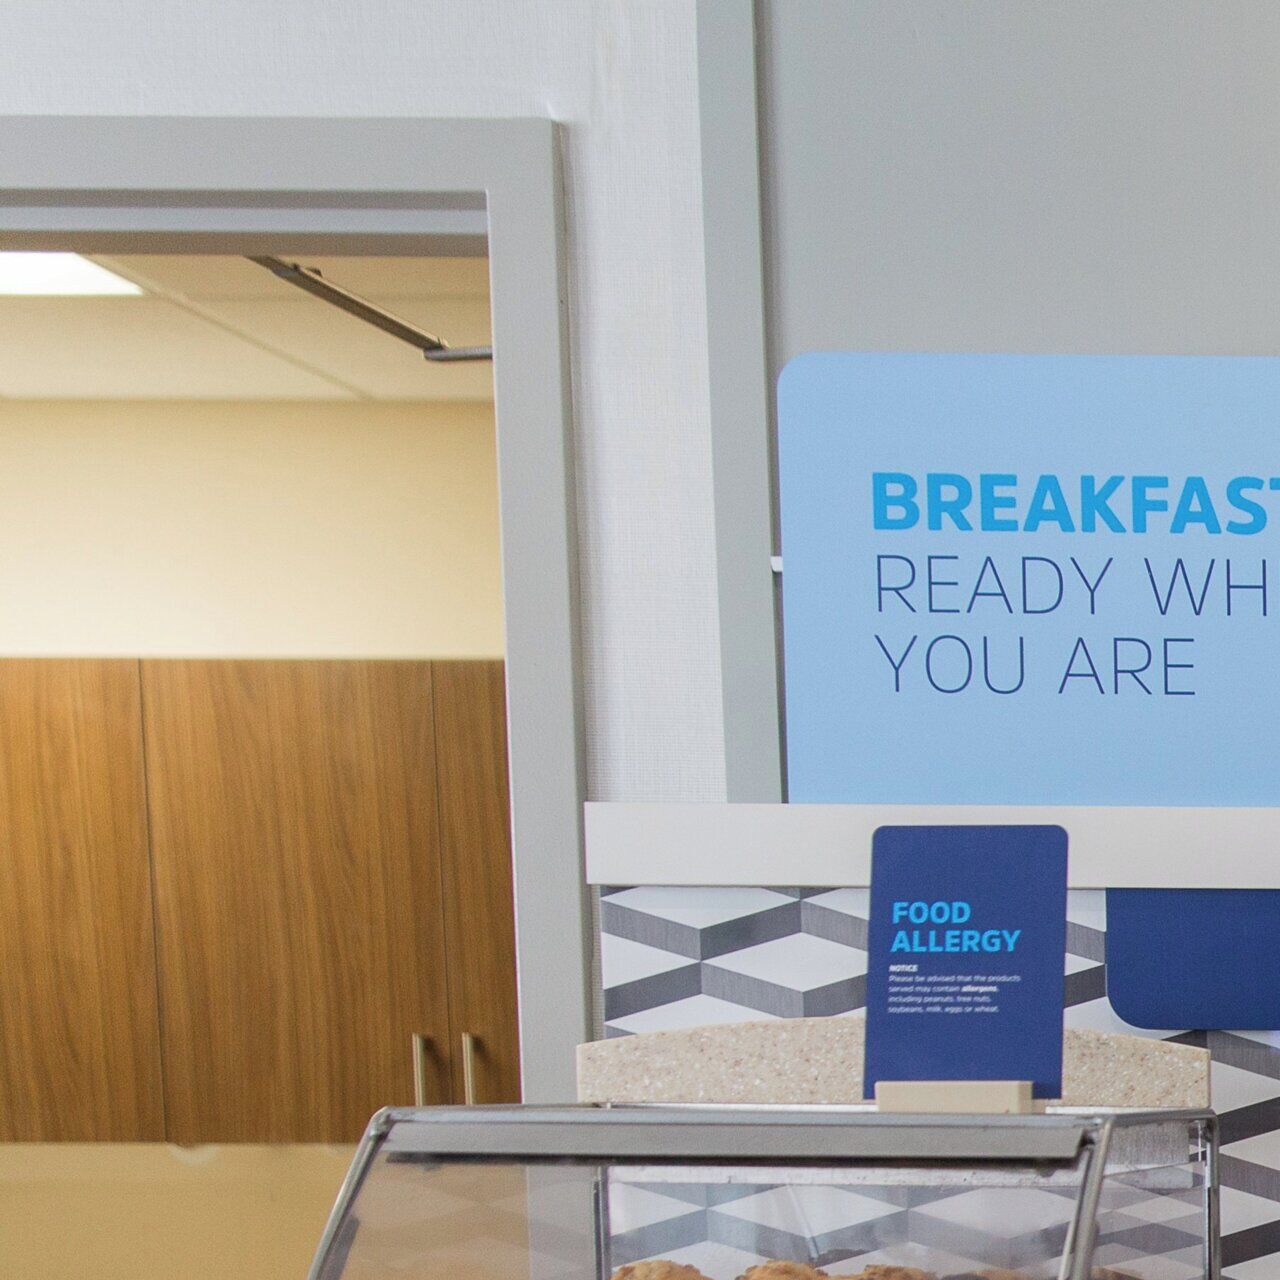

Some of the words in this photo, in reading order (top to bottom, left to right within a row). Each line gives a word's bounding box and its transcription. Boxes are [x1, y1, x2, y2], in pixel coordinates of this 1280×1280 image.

[874, 555, 1113, 616] READY
[873, 634, 1027, 695] YOU
[1058, 636, 1196, 696] ARE
[892, 901, 971, 924] FOOD
[890, 929, 1021, 953] ALLERGY
